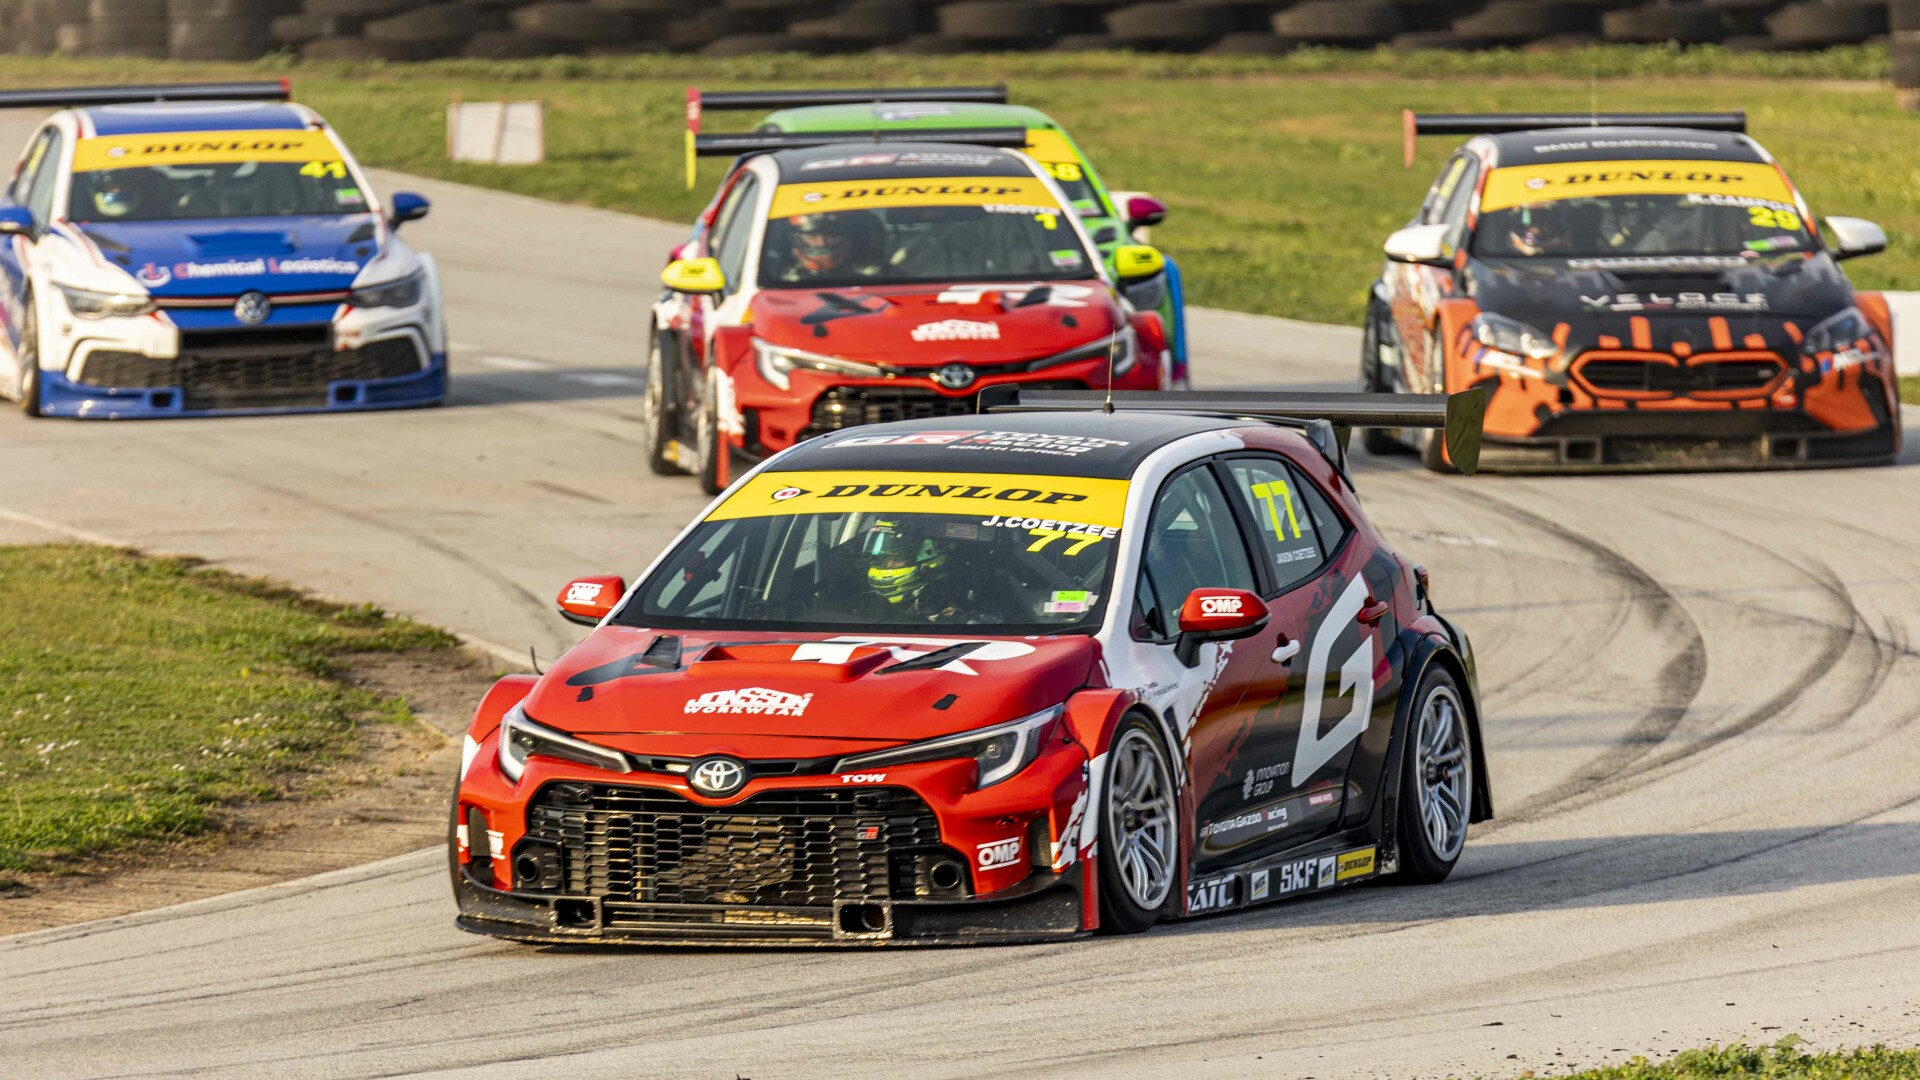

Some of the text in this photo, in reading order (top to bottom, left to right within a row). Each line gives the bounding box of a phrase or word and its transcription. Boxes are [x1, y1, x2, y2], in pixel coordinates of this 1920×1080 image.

[141, 140, 305, 154] DUNLOP
[299, 159, 346, 178] 41
[1566, 171, 1744, 185] DUNLOP
[840, 186, 1023, 200] DUNLOP
[1034, 213, 1058, 230] 1
[1748, 206, 1801, 231] 29
[173, 259, 266, 279] Chemical
[1579, 293, 1767, 306] VELOCE
[817, 484, 1089, 505] DUNLOP
[1251, 480, 1301, 541] 77
[982, 515, 1122, 539] J.COETZEE
[1026, 529, 1102, 555] 77
[567, 585, 601, 601] OMP
[1201, 599, 1243, 614] OMP
[686, 687, 812, 709] JONSSON
[683, 705, 805, 717] WORKWEAR
[840, 773, 887, 784] TOW
[978, 841, 1021, 867] OMP
[1344, 856, 1372, 871] DUNLOP
[1280, 858, 1318, 893] SKF
